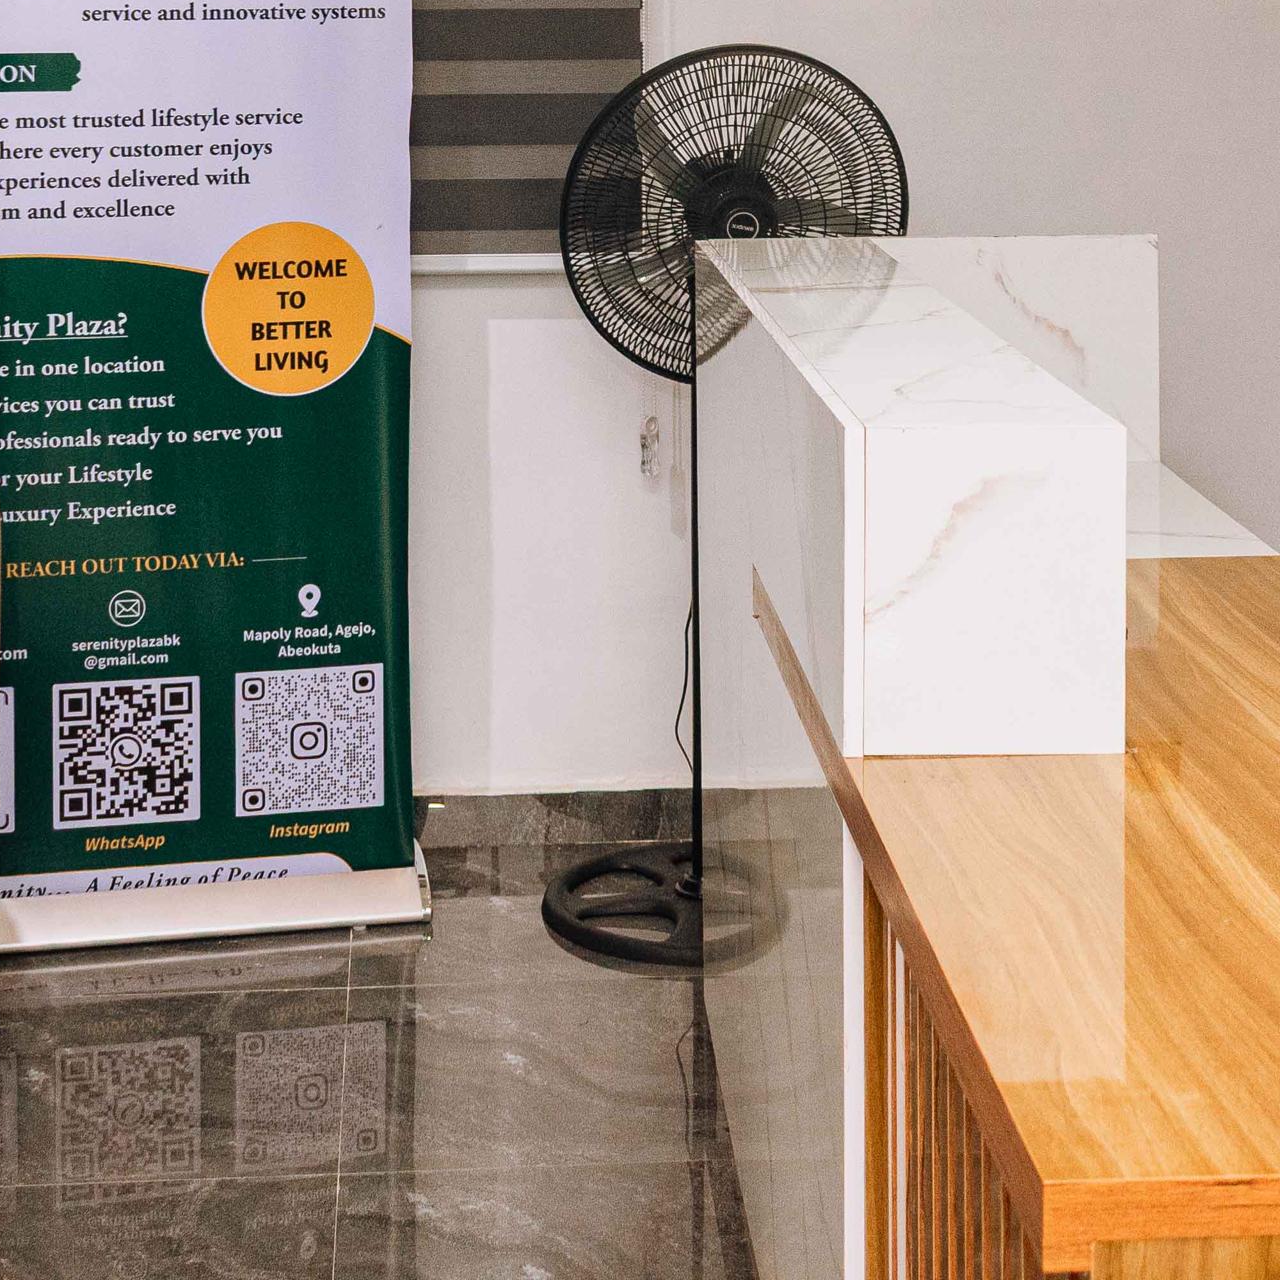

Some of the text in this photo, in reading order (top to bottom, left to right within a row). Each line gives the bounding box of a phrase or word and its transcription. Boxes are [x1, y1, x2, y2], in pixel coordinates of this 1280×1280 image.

[81, 1, 386, 25] service and innovative systems
[15, 115, 67, 129] most
[72, 108, 146, 129] trusted
[151, 107, 230, 132] lifestyle
[235, 107, 303, 126] service
[49, 146, 104, 164] every
[109, 144, 204, 158] customer
[209, 138, 273, 161] enjoys
[107, 167, 200, 188] delivered
[204, 166, 251, 185] with
[27, 200, 66, 220] and
[72, 198, 175, 219] excellence
[234, 258, 348, 281] WELCOME
[276, 290, 306, 310] TO
[46, 311, 128, 337] Plaza?
[251, 320, 333, 341] BETTER
[14, 359, 36, 377] in
[41, 363, 79, 376] one
[84, 355, 165, 375] location
[255, 350, 329, 374] LIVING
[44, 399, 83, 419] you
[87, 397, 124, 412] can
[128, 393, 177, 410] trust
[107, 425, 163, 450] ready
[166, 430, 188, 444] to
[193, 428, 242, 443] serve
[246, 426, 283, 446] you
[15, 472, 63, 492] your
[68, 462, 153, 487] Lifestyle
[0, 500, 177, 527] uxury Experience
[6, 550, 246, 579] REACH OUT TODAY VIA:
[71, 633, 181, 652] serenityplazabk
[243, 621, 376, 644] Mapoly Road, Agejo,
[84, 652, 169, 670] @gmail.com
[278, 642, 341, 658] Abeokuta
[269, 822, 350, 839] Instagram
[85, 834, 165, 852] WhatsApp
[85, 877, 98, 893] A
[198, 867, 223, 885] of
